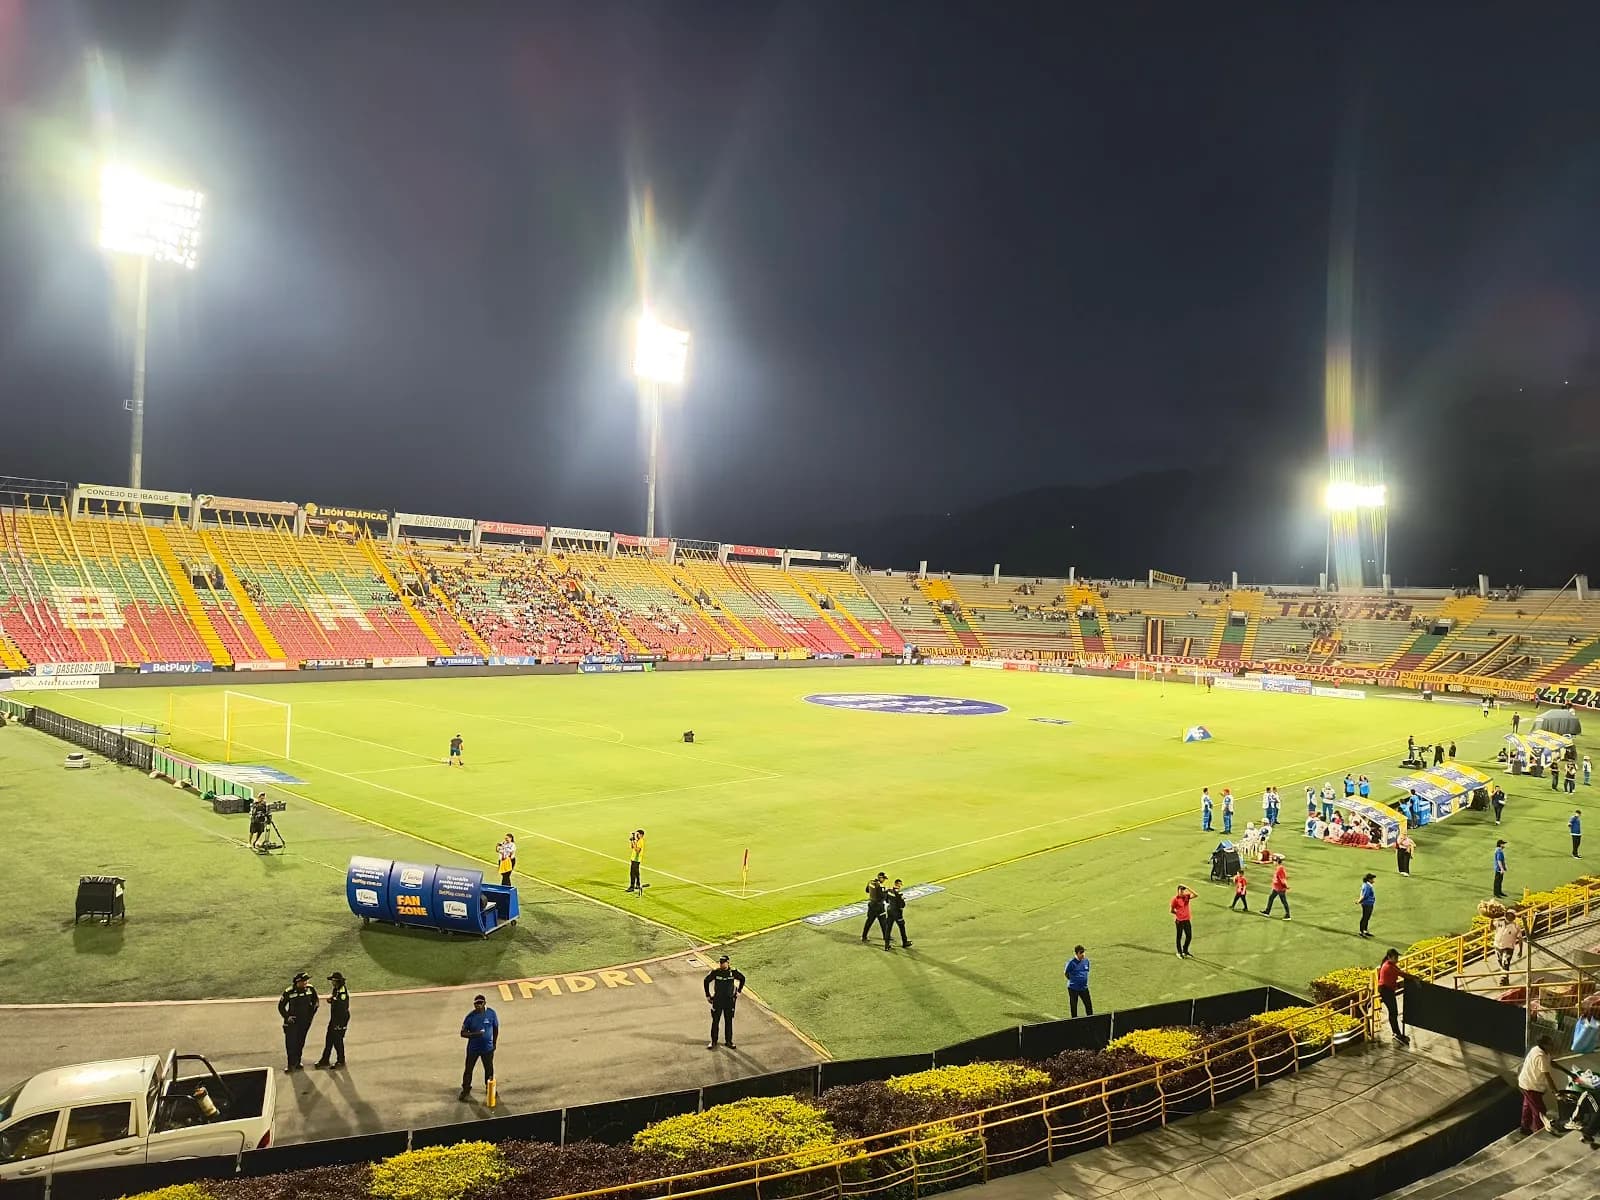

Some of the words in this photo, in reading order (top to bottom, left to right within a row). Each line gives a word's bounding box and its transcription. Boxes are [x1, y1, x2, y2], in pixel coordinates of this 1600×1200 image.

[87, 488, 124, 498] CONCEJO
[140, 493, 169, 502] IBAGUÉ
[319, 506, 344, 517] LEÓN
[345, 510, 388, 521] GRÁFICAS
[414, 515, 451, 528] GASEOSAS
[452, 520, 471, 530] POOL
[56, 663, 93, 674] GASEOSAS
[94, 662, 112, 673] POOL
[153, 663, 190, 673] BetPlay
[1152, 655, 1254, 669] REVOLUCION
[1263, 663, 1356, 675] VINOTINTO
[1366, 669, 1398, 679] SUR
[38, 678, 98, 687] Multicentro
[397, 895, 421, 907] FAN
[397, 906, 428, 916] ZONE
[498, 967, 653, 1002] IMDRI
